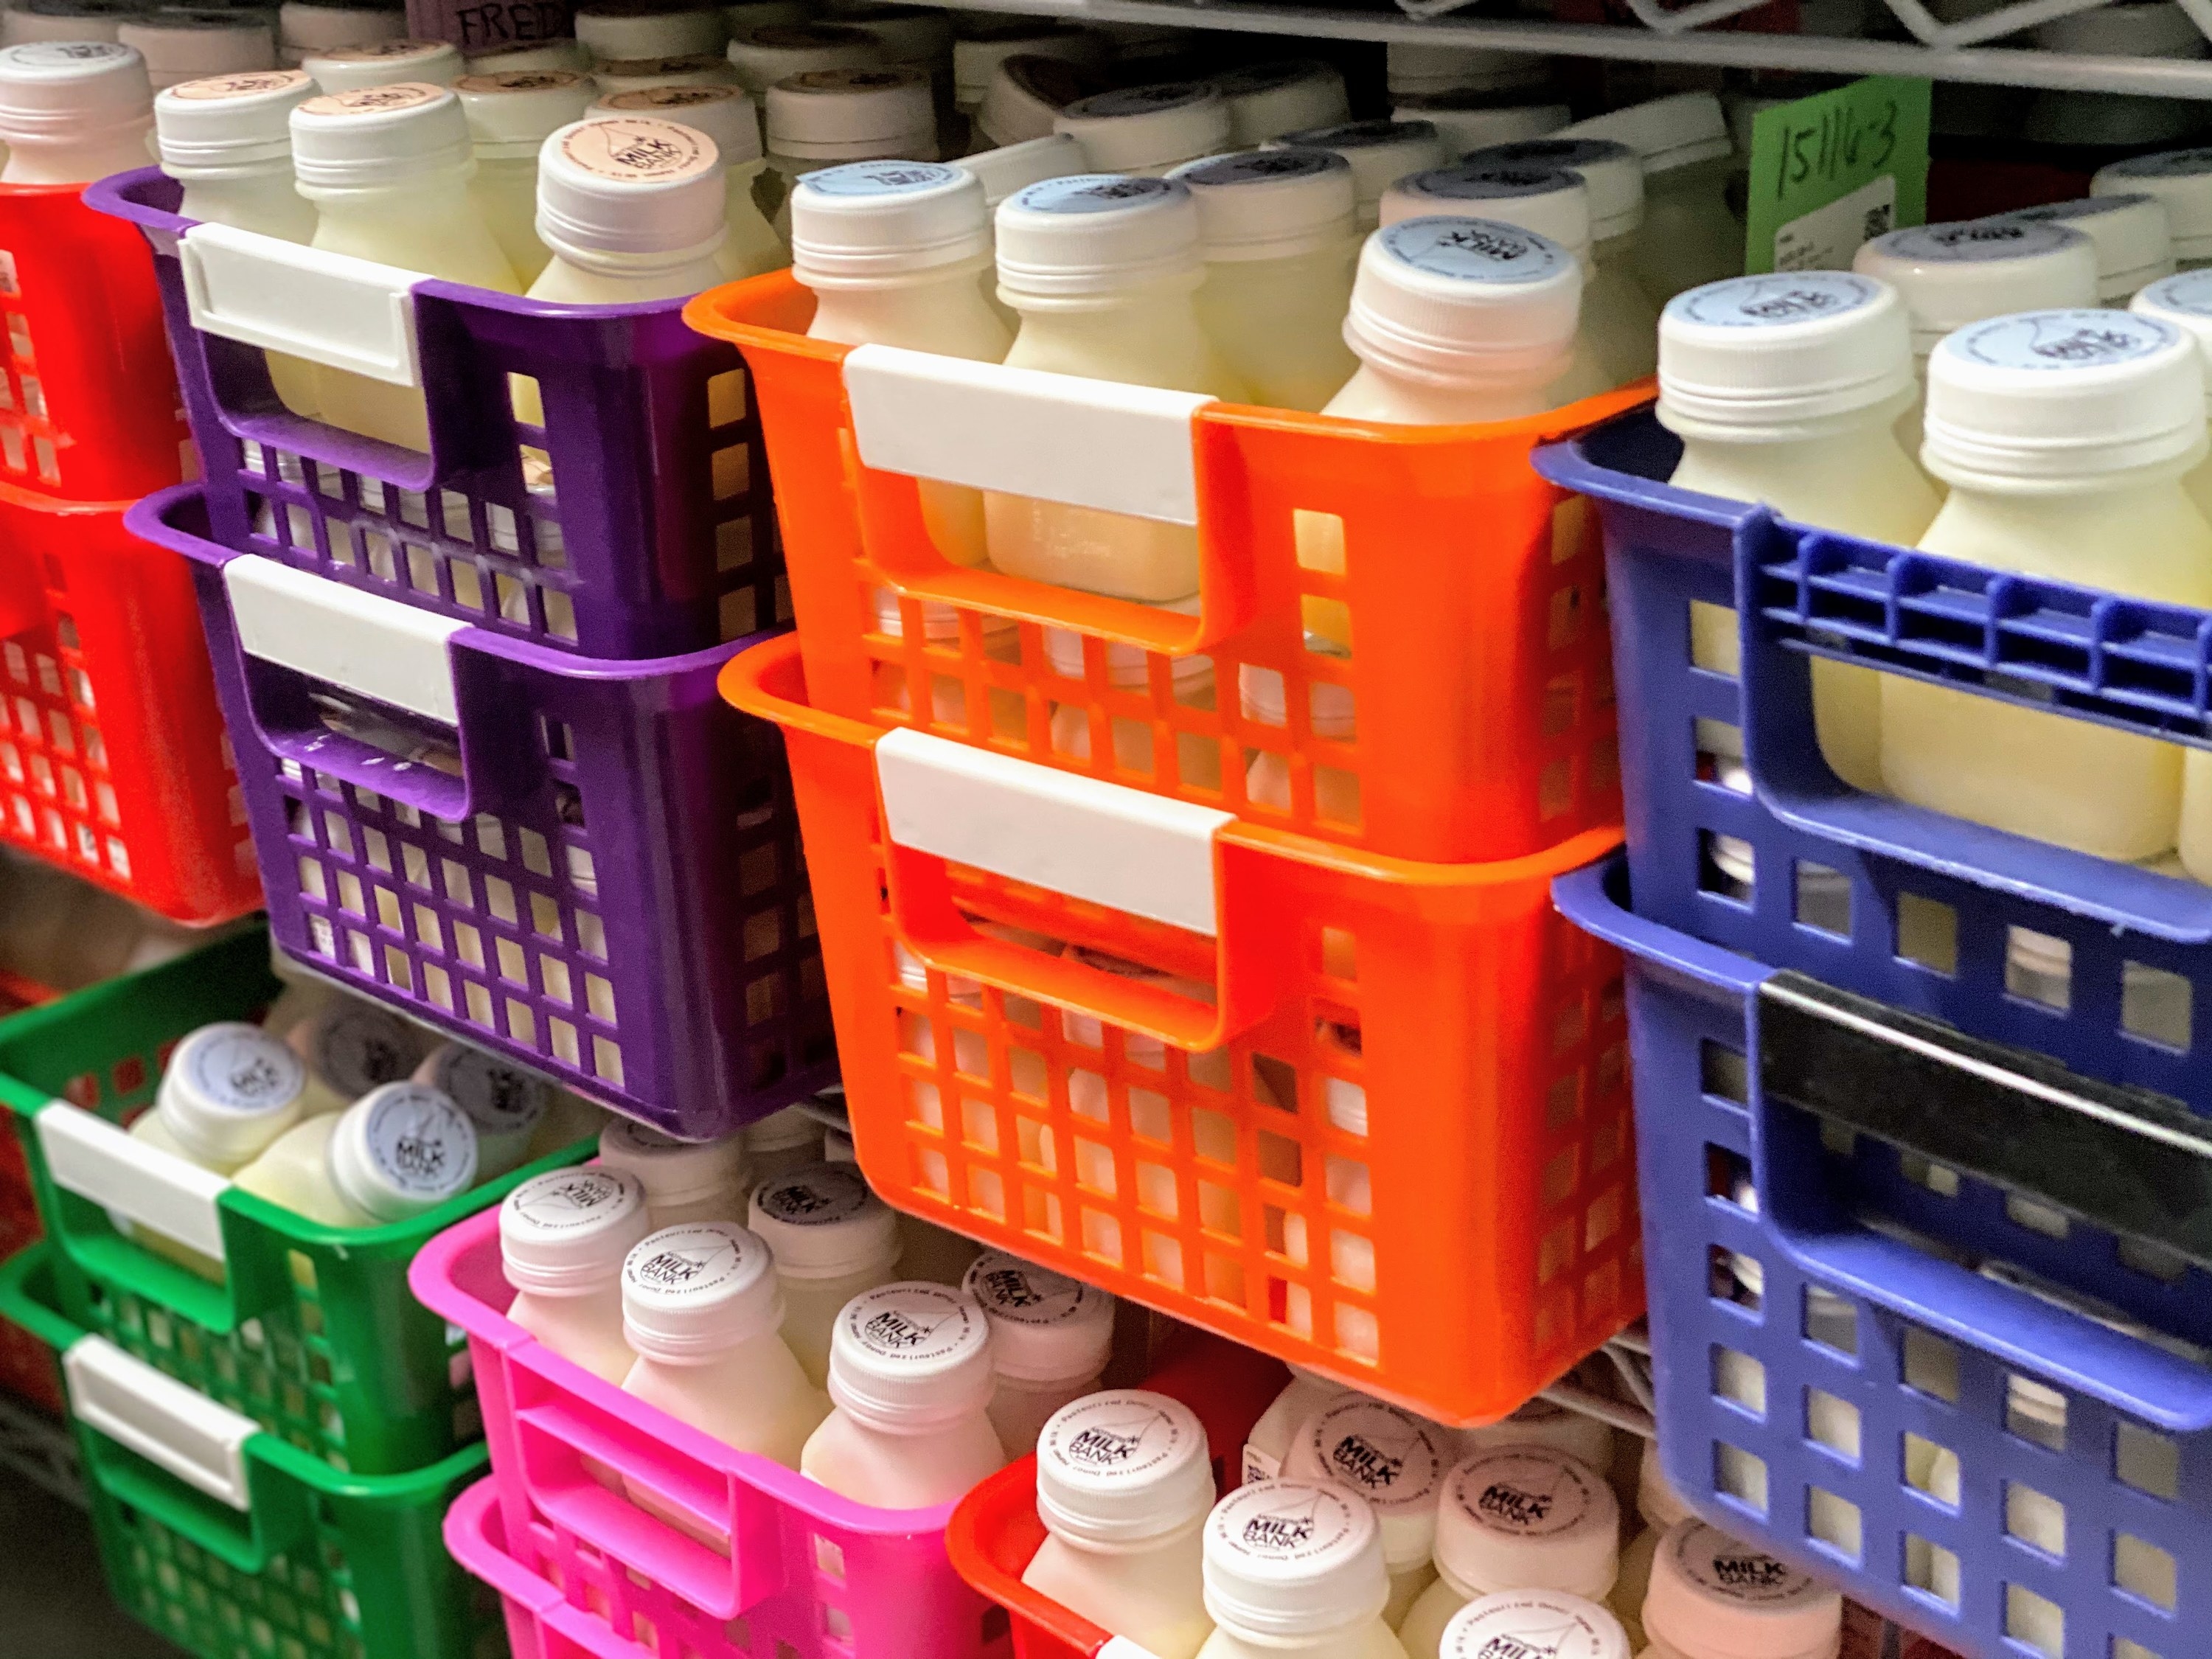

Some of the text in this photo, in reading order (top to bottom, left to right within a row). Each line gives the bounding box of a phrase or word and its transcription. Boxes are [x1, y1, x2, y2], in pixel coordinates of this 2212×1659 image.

[616, 139, 671, 164] MILK
[395, 1136, 445, 1167] MILK
[559, 1183, 597, 1207] MILK
[641, 1262, 682, 1285] BANK
[650, 1253, 699, 1281] MILK
[999, 1270, 1032, 1307] MILK
[866, 1319, 908, 1349] BANK
[875, 1311, 926, 1346] MILK
[1069, 1441, 1119, 1465] BANK
[1076, 1430, 1136, 1461] MILK
[1333, 1447, 1383, 1489] BANK
[1339, 1436, 1399, 1486] MILK
[1481, 1485, 1550, 1519] MILK
[1242, 1530, 1298, 1549] BANK
[1246, 1518, 1314, 1540] MILK
[1712, 1559, 1787, 1576] MILK
